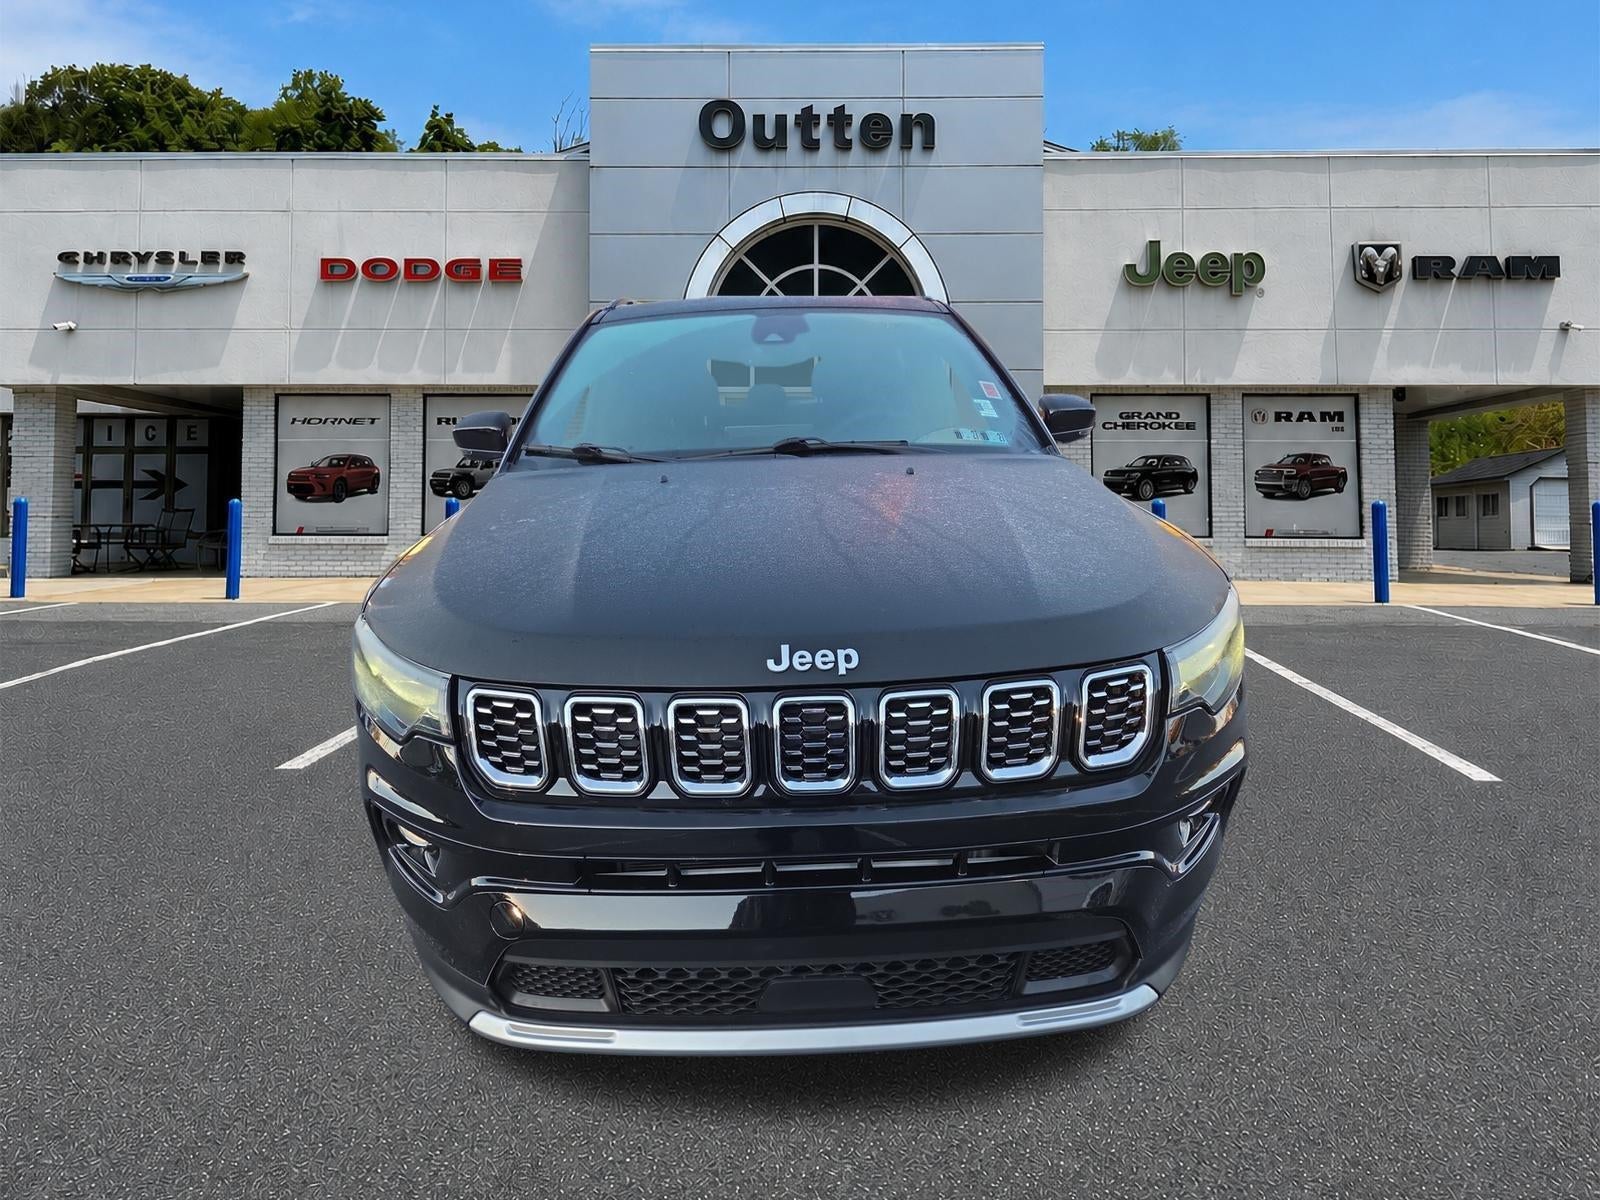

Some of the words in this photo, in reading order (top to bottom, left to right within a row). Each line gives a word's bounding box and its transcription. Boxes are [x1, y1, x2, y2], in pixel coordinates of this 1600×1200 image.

[698, 99, 936, 150] Outten
[57, 250, 247, 266] CHRYSLER
[1123, 240, 1266, 296] Jeep
[1411, 255, 1561, 280] RAM
[319, 258, 523, 283] DODGE
[290, 416, 381, 426] HORNET
[1118, 411, 1181, 420] GRAND
[1273, 410, 1345, 423] RAM
[1101, 421, 1197, 431] CHEROKEE
[766, 643, 860, 676] Jeep
